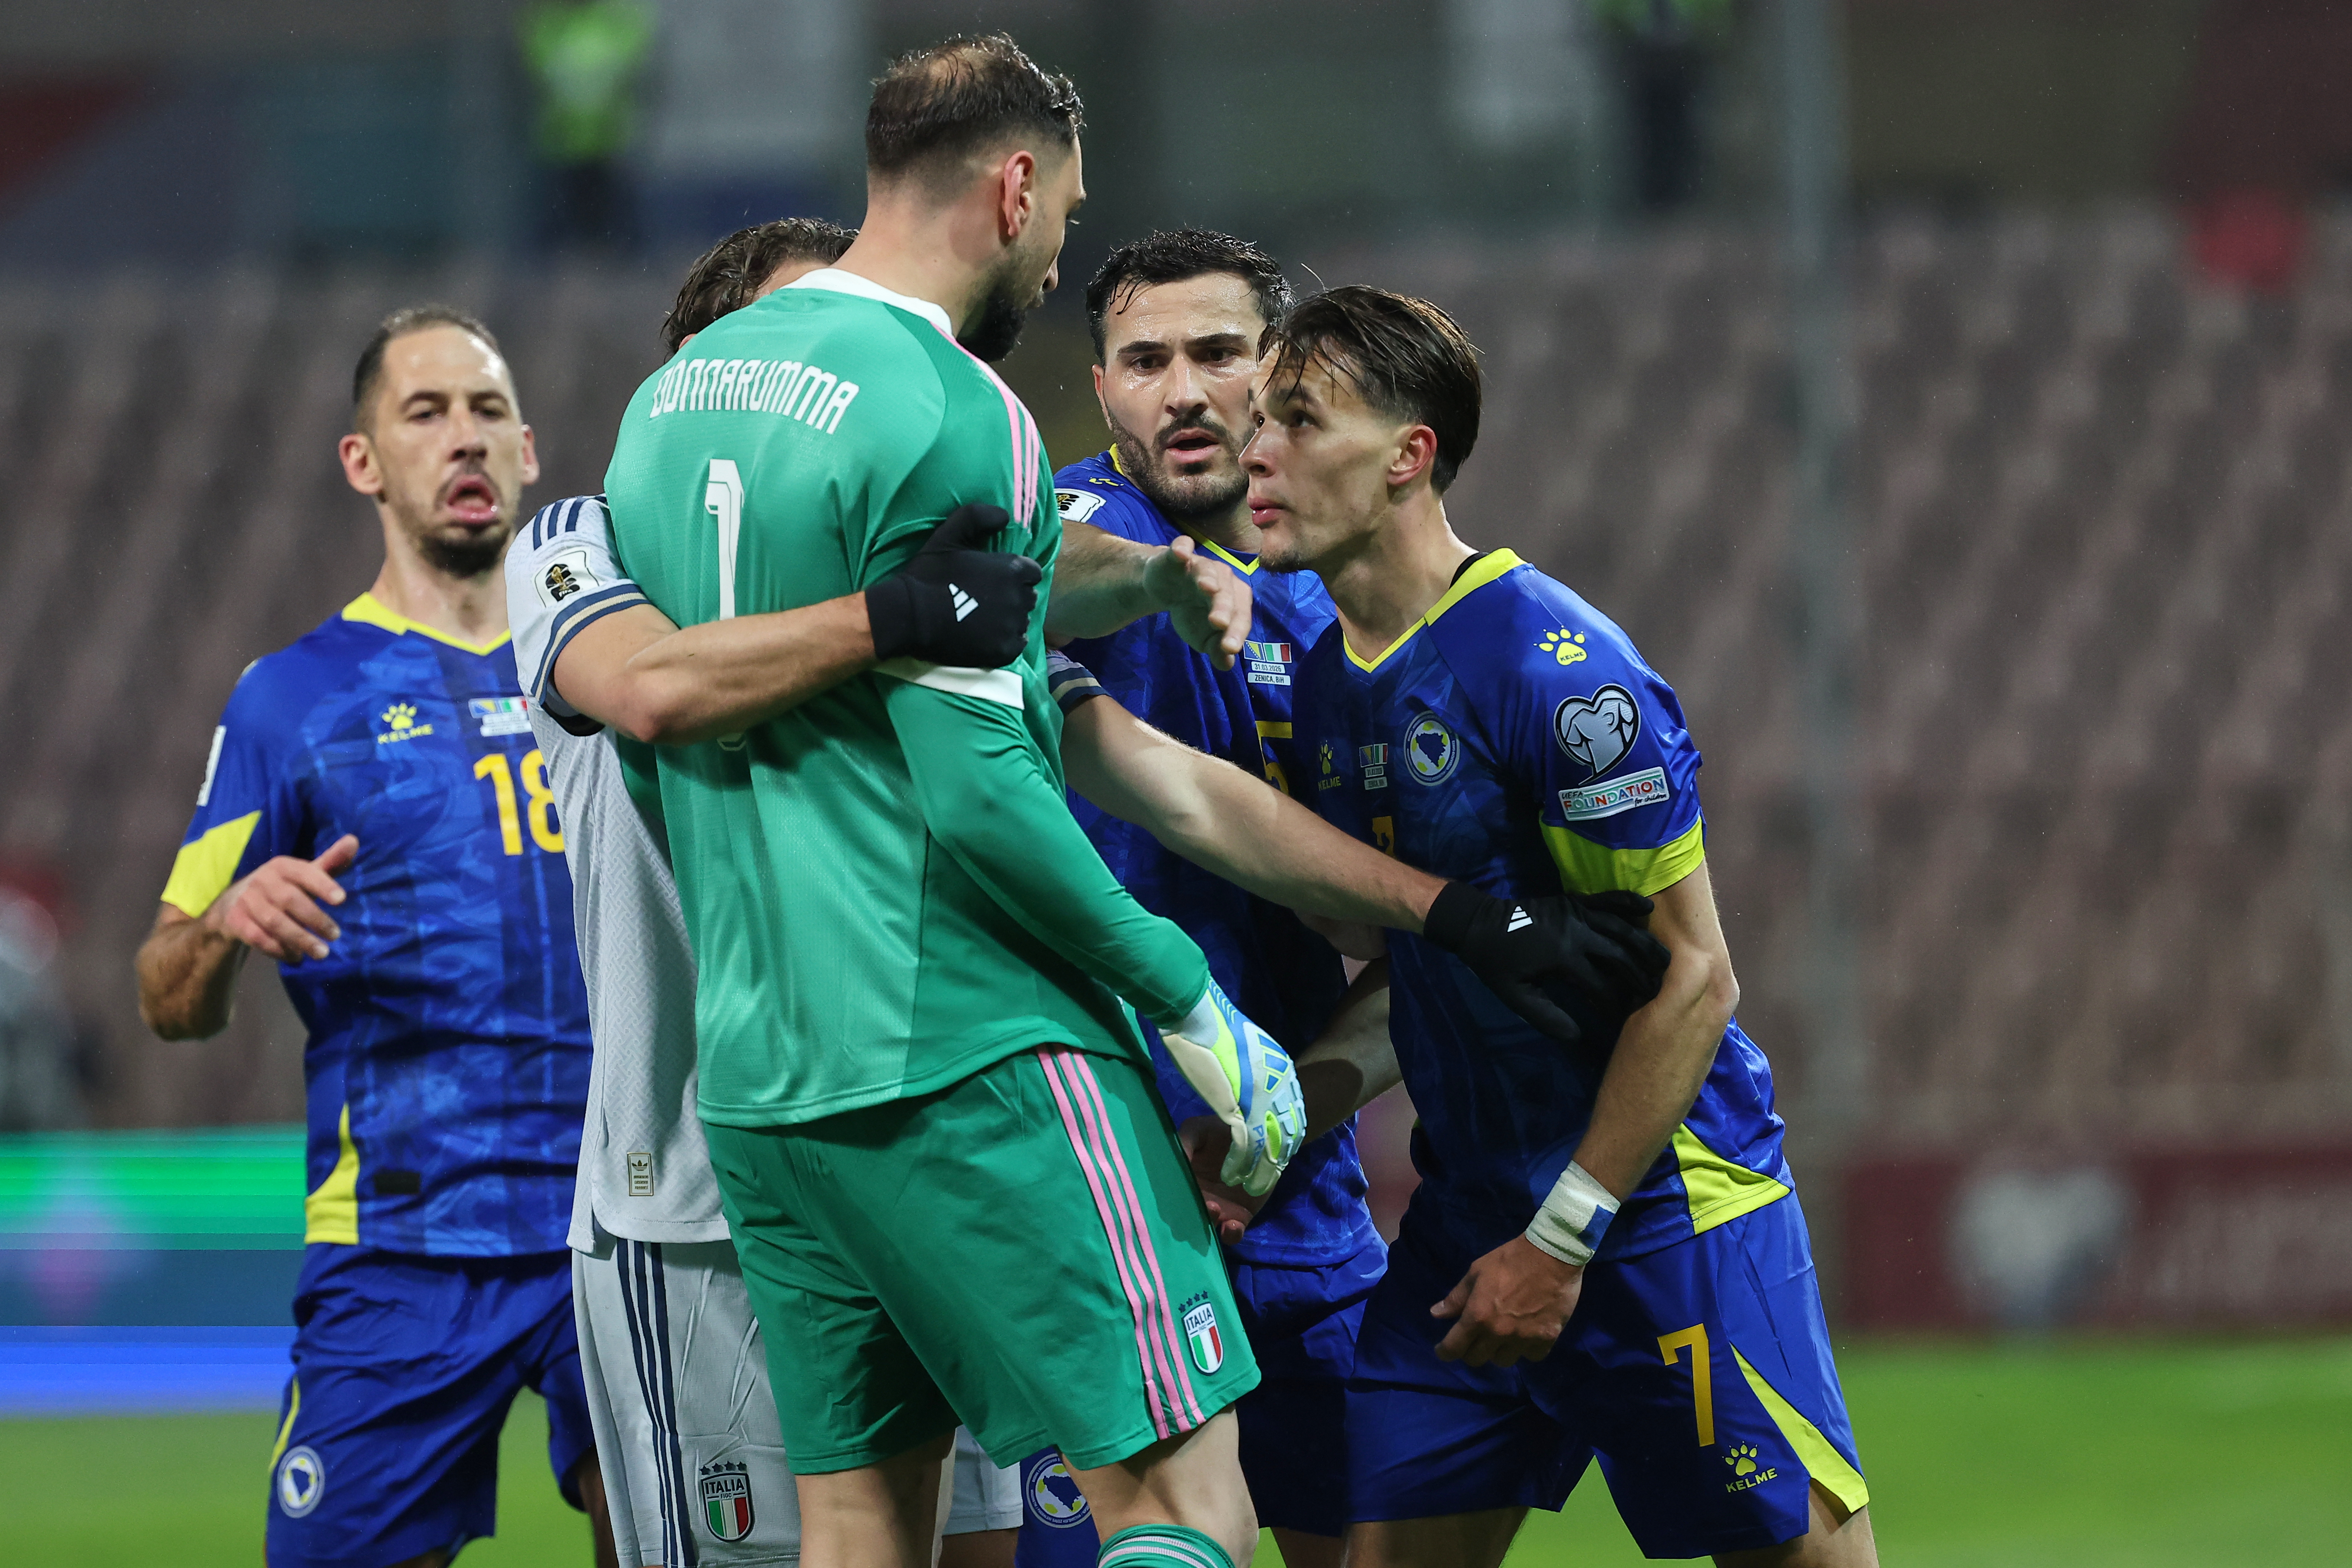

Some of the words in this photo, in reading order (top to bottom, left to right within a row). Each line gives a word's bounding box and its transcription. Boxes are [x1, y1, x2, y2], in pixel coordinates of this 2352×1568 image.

[649, 358, 860, 434] DONNARUMMA
[1560, 652, 1584, 661] KELME
[1254, 663, 1281, 672] 31.03.2026
[1254, 675, 1275, 683] ZENICA,
[473, 748, 565, 856] 18
[1562, 791, 1584, 799] UEFA
[1634, 798, 1642, 807] for
[1644, 794, 1667, 802] children
[1186, 1307, 1213, 1331] ITALIA
[1656, 1323, 1715, 1447] 7
[705, 1478, 745, 1494] ITALIA
[1725, 1468, 1778, 1493] KELME
